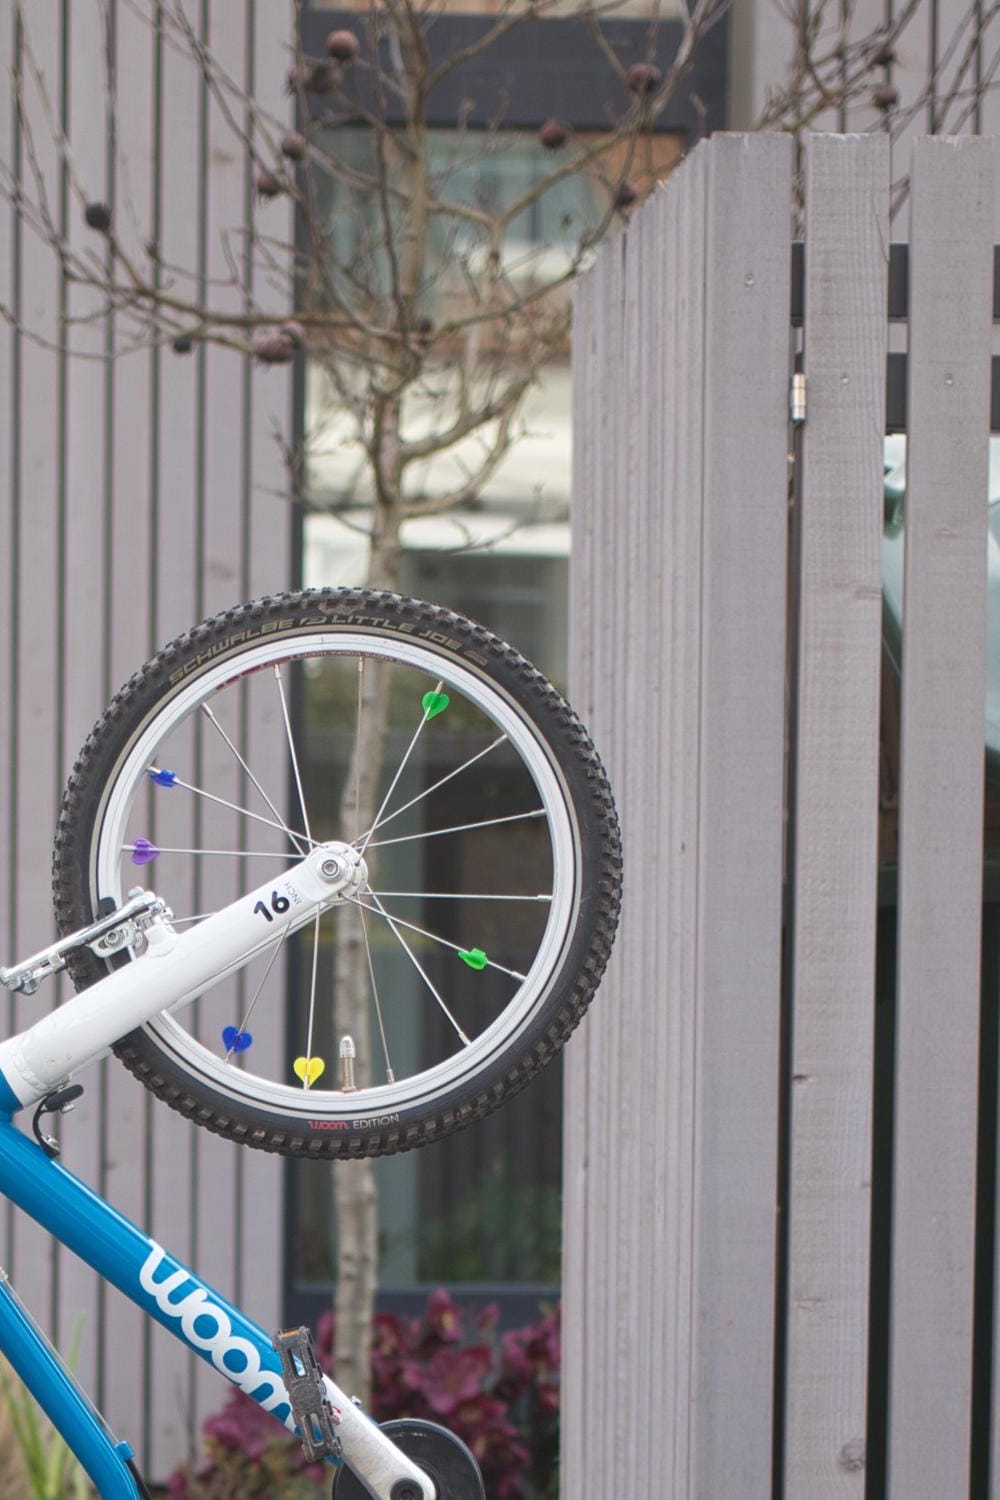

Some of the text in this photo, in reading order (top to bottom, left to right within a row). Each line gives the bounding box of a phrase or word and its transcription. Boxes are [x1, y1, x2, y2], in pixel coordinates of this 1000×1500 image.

[168, 618, 295, 686] SCHWALBE
[331, 615, 416, 633] LITTLE
[418, 629, 463, 651] JOE
[253, 890, 290, 922] 16
[308, 1113, 400, 1130] woom EDITION
[139, 1238, 299, 1434] woom
